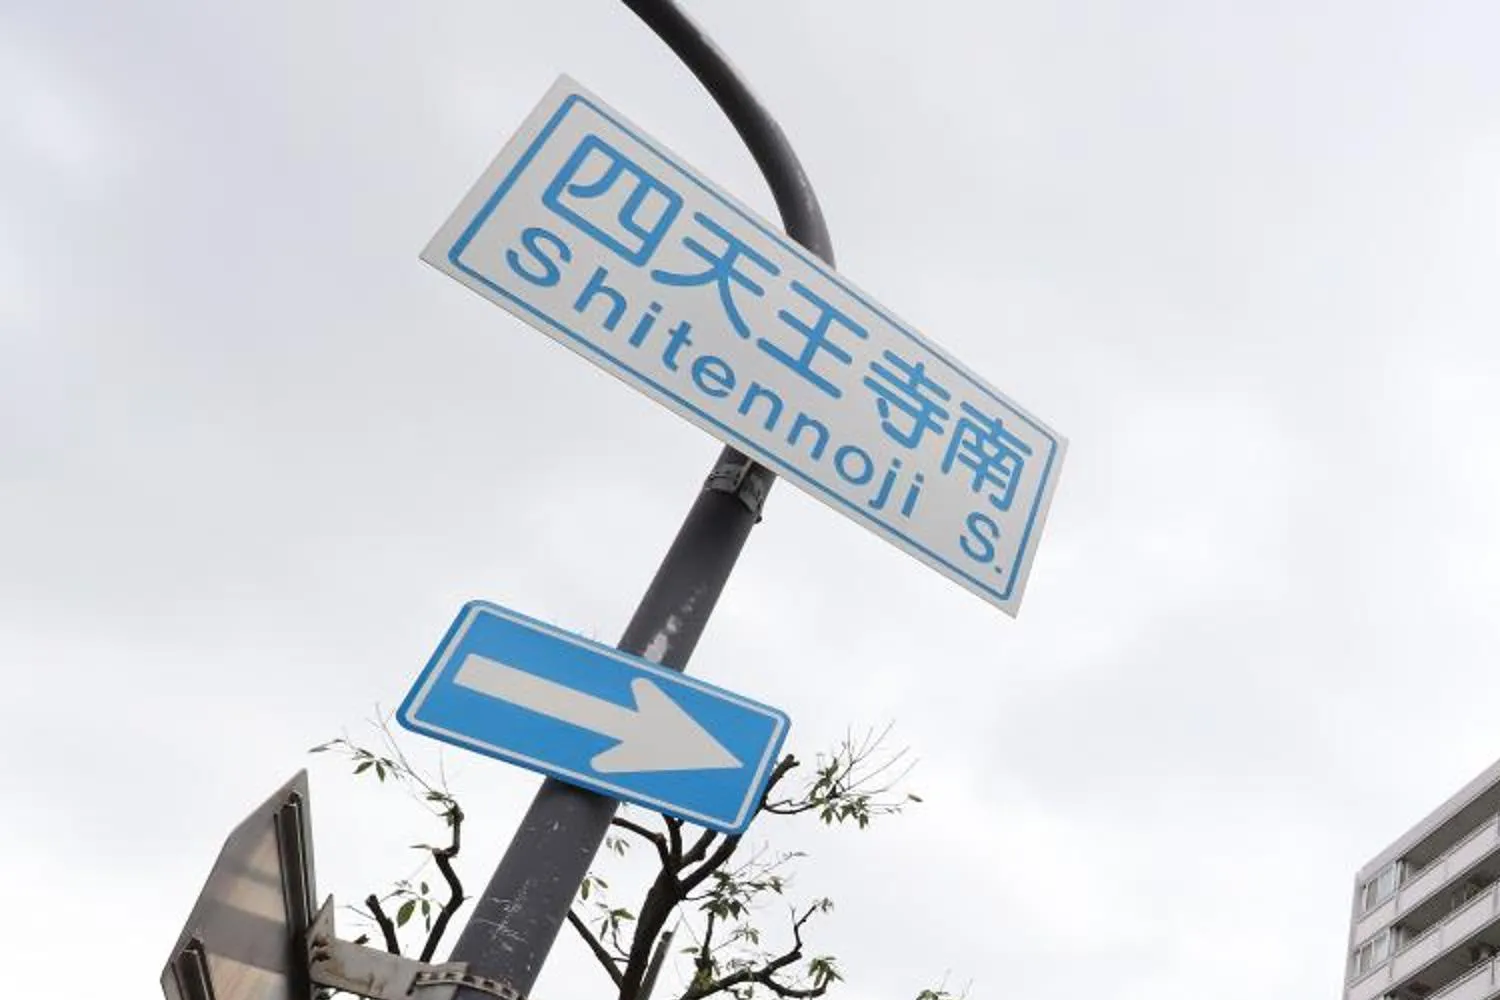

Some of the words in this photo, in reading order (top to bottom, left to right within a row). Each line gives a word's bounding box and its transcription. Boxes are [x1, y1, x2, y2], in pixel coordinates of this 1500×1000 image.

[505, 226, 925, 519] Shitennoji
[958, 511, 1004, 574] S.
[541, 133, 1034, 513] 四天王寺南
